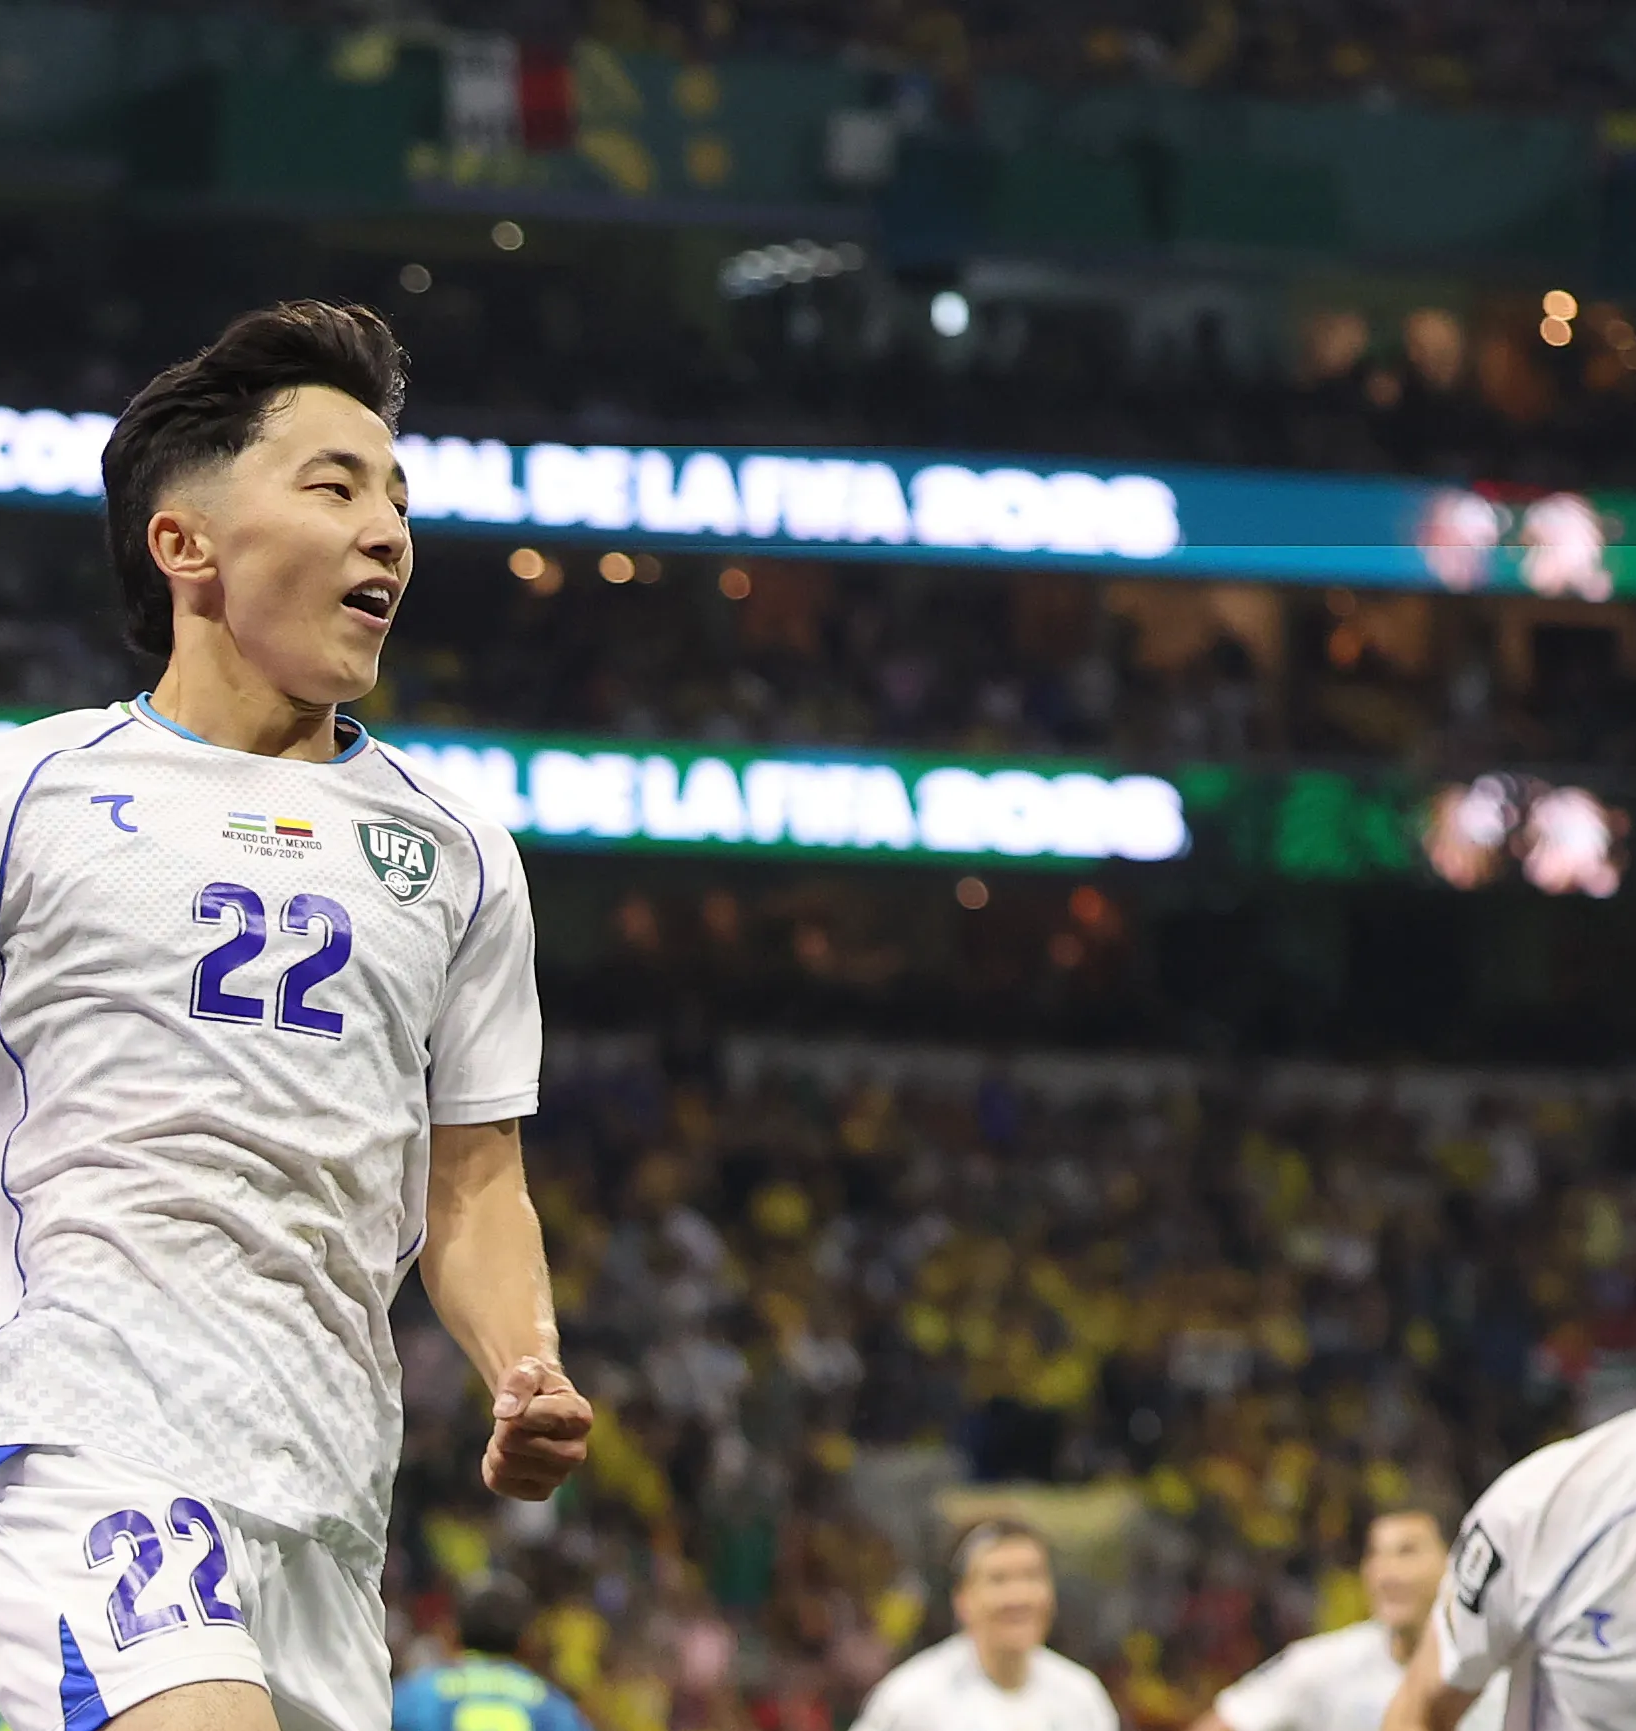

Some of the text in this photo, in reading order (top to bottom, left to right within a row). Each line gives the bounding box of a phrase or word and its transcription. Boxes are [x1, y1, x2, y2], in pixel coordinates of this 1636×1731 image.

[222, 830, 258, 843] MEXICO
[286, 838, 322, 850] MEXICO
[243, 844, 305, 859] 17/06/2026
[369, 828, 427, 874] UFA
[190, 881, 353, 1041] 22
[83, 1496, 247, 1652] 22
